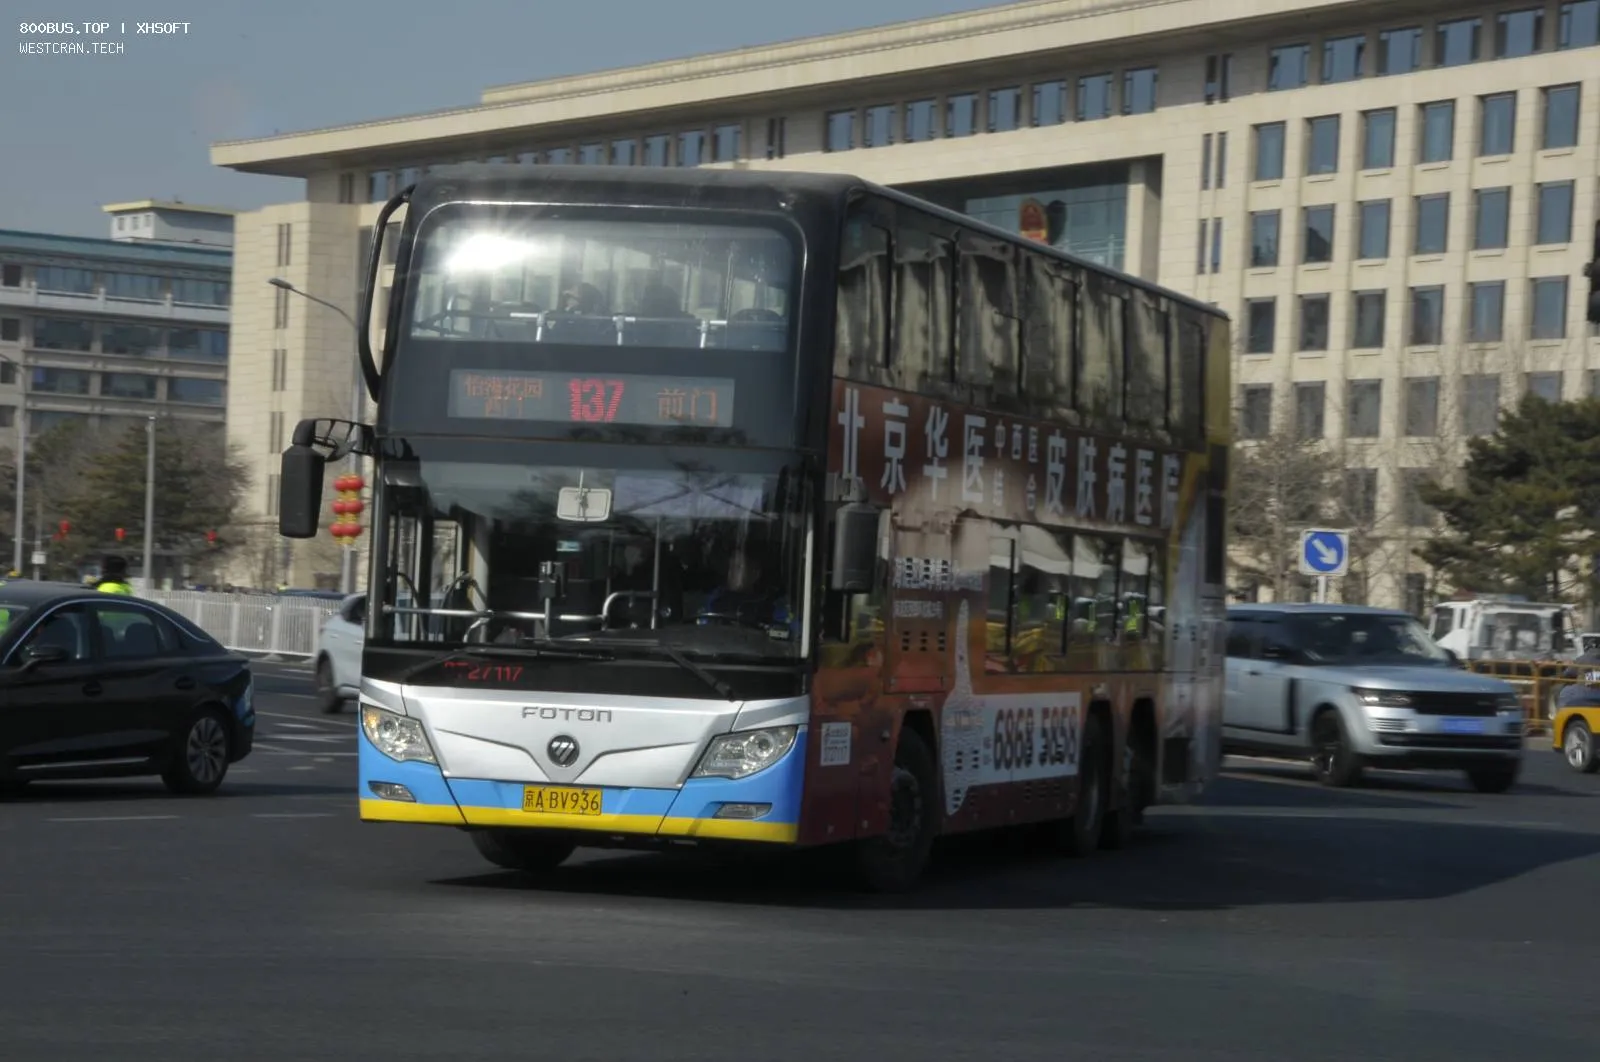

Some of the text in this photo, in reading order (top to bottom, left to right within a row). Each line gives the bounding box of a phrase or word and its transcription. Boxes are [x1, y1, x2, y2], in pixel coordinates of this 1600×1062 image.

[568, 378, 625, 422] 137
[656, 387, 718, 423] 前门
[522, 706, 612, 723] FOTON
